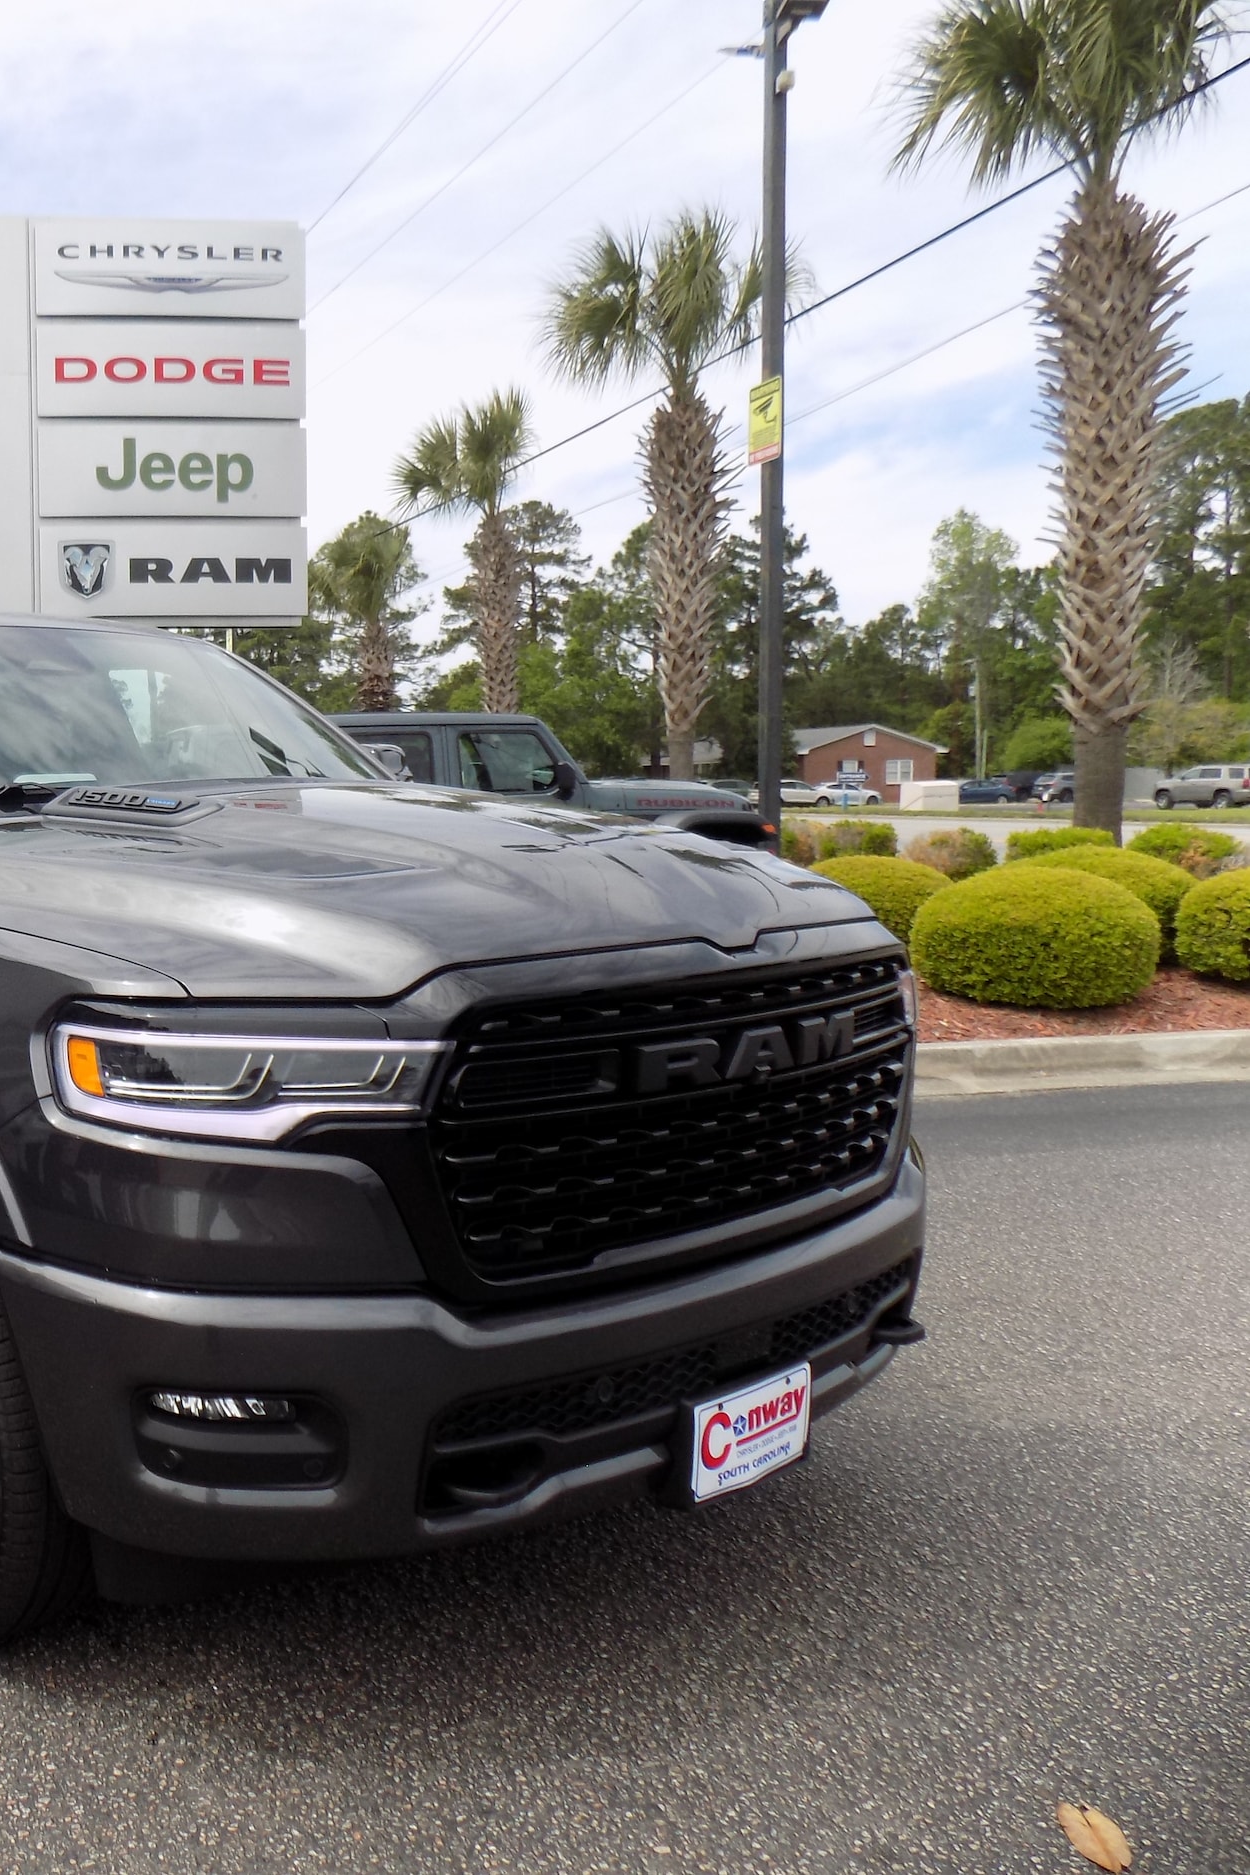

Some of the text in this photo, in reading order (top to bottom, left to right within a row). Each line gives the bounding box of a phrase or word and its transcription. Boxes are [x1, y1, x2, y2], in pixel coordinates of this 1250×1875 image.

[57, 244, 284, 263] CHRYSLER
[54, 357, 291, 386] DODGE
[95, 437, 255, 503] Jeep
[129, 557, 293, 584] RAM
[75, 788, 148, 807] 1500
[637, 798, 736, 809] RUBICON
[637, 1009, 855, 1093] RAM
[717, 1464, 750, 1486] SOUTH
[752, 1441, 791, 1469] CAROLINA
